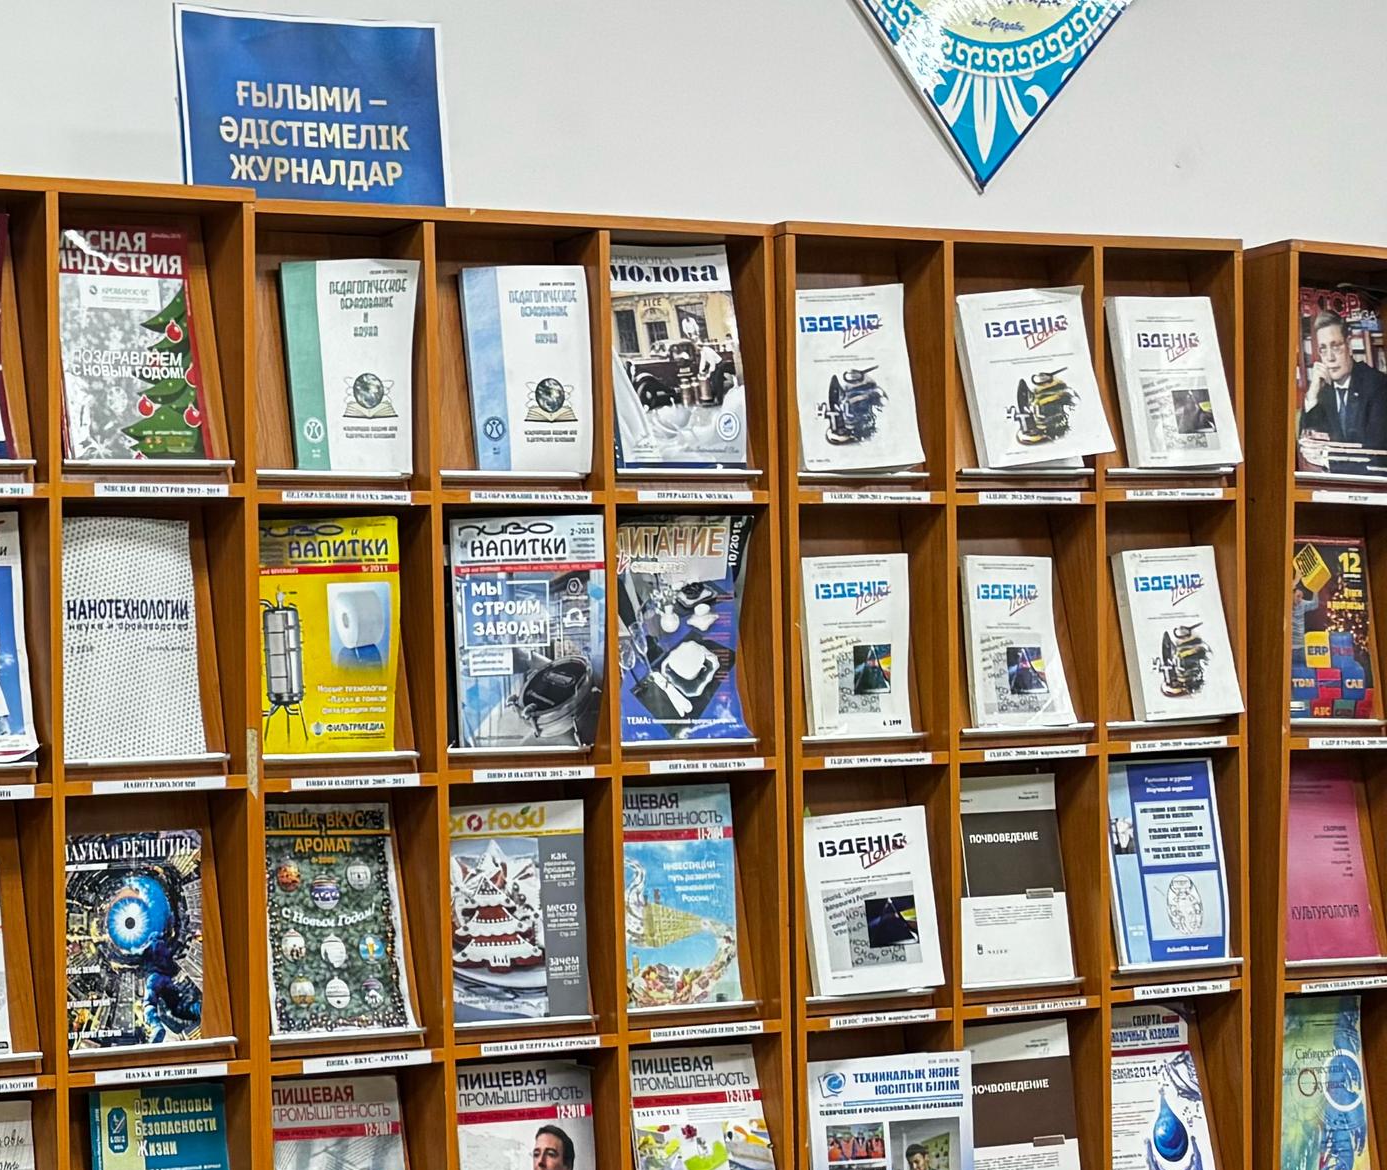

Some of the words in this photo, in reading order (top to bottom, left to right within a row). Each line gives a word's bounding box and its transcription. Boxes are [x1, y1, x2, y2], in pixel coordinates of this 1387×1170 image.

[237, 80, 361, 113] ҒЫЛЫМИ
[219, 116, 409, 150] ӘДІСТЕМЕЛІК
[229, 154, 403, 192] ЖУРНАЛДАР
[611, 263, 717, 282] МОЛОКА
[73, 350, 182, 367] ПОЗДРАВЛЯЕМ
[73, 366, 81, 375] С
[83, 366, 131, 378] НОВЫМ
[135, 367, 184, 380] ГОДОМ!
[289, 539, 389, 557] НАПИТКИ
[471, 538, 566, 557] НАПИТКИ
[618, 526, 726, 558] ПИТАНИЕ
[728, 521, 742, 567] 10/2015
[1339, 552, 1361, 573] 12
[471, 582, 502, 596] МЫ
[67, 599, 189, 621] НАНОТЕХНОЛОГИИ
[472, 600, 540, 616] СТРОИМ
[473, 620, 544, 636] ЗАВОДЫ
[326, 722, 385, 733] ФИЛЬТРМЕДИА
[327, 812, 365, 828] ВКУС
[295, 838, 352, 852] АРОМАТ
[969, 830, 1039, 843] ПОЧВОВЕДЕНИЕ
[121, 838, 191, 858] РЕЛИГИЯ
[1292, 904, 1359, 920] КУЛЬТУРОЛОГИЯ
[632, 1055, 714, 1075] ПИЩЕВАЯ
[929, 1067, 959, 1078] ЖӘНЕ
[1134, 1066, 1157, 1078] 2014
[458, 1069, 547, 1091] ПИЩЕВАЯ
[633, 1071, 750, 1091] ПРОМЫШЛЕННОСТЬ
[926, 1080, 959, 1092] БІЛІМ
[972, 1078, 1049, 1096] ПОЧВОВЕДЕНИЕ
[273, 1083, 355, 1104] ПИЩЕВАЯ
[459, 1084, 583, 1107] ПРОМЫШЛЕННОСТЬ
[273, 1101, 391, 1122] ПРОМЫШЛЕННОСТЬ
